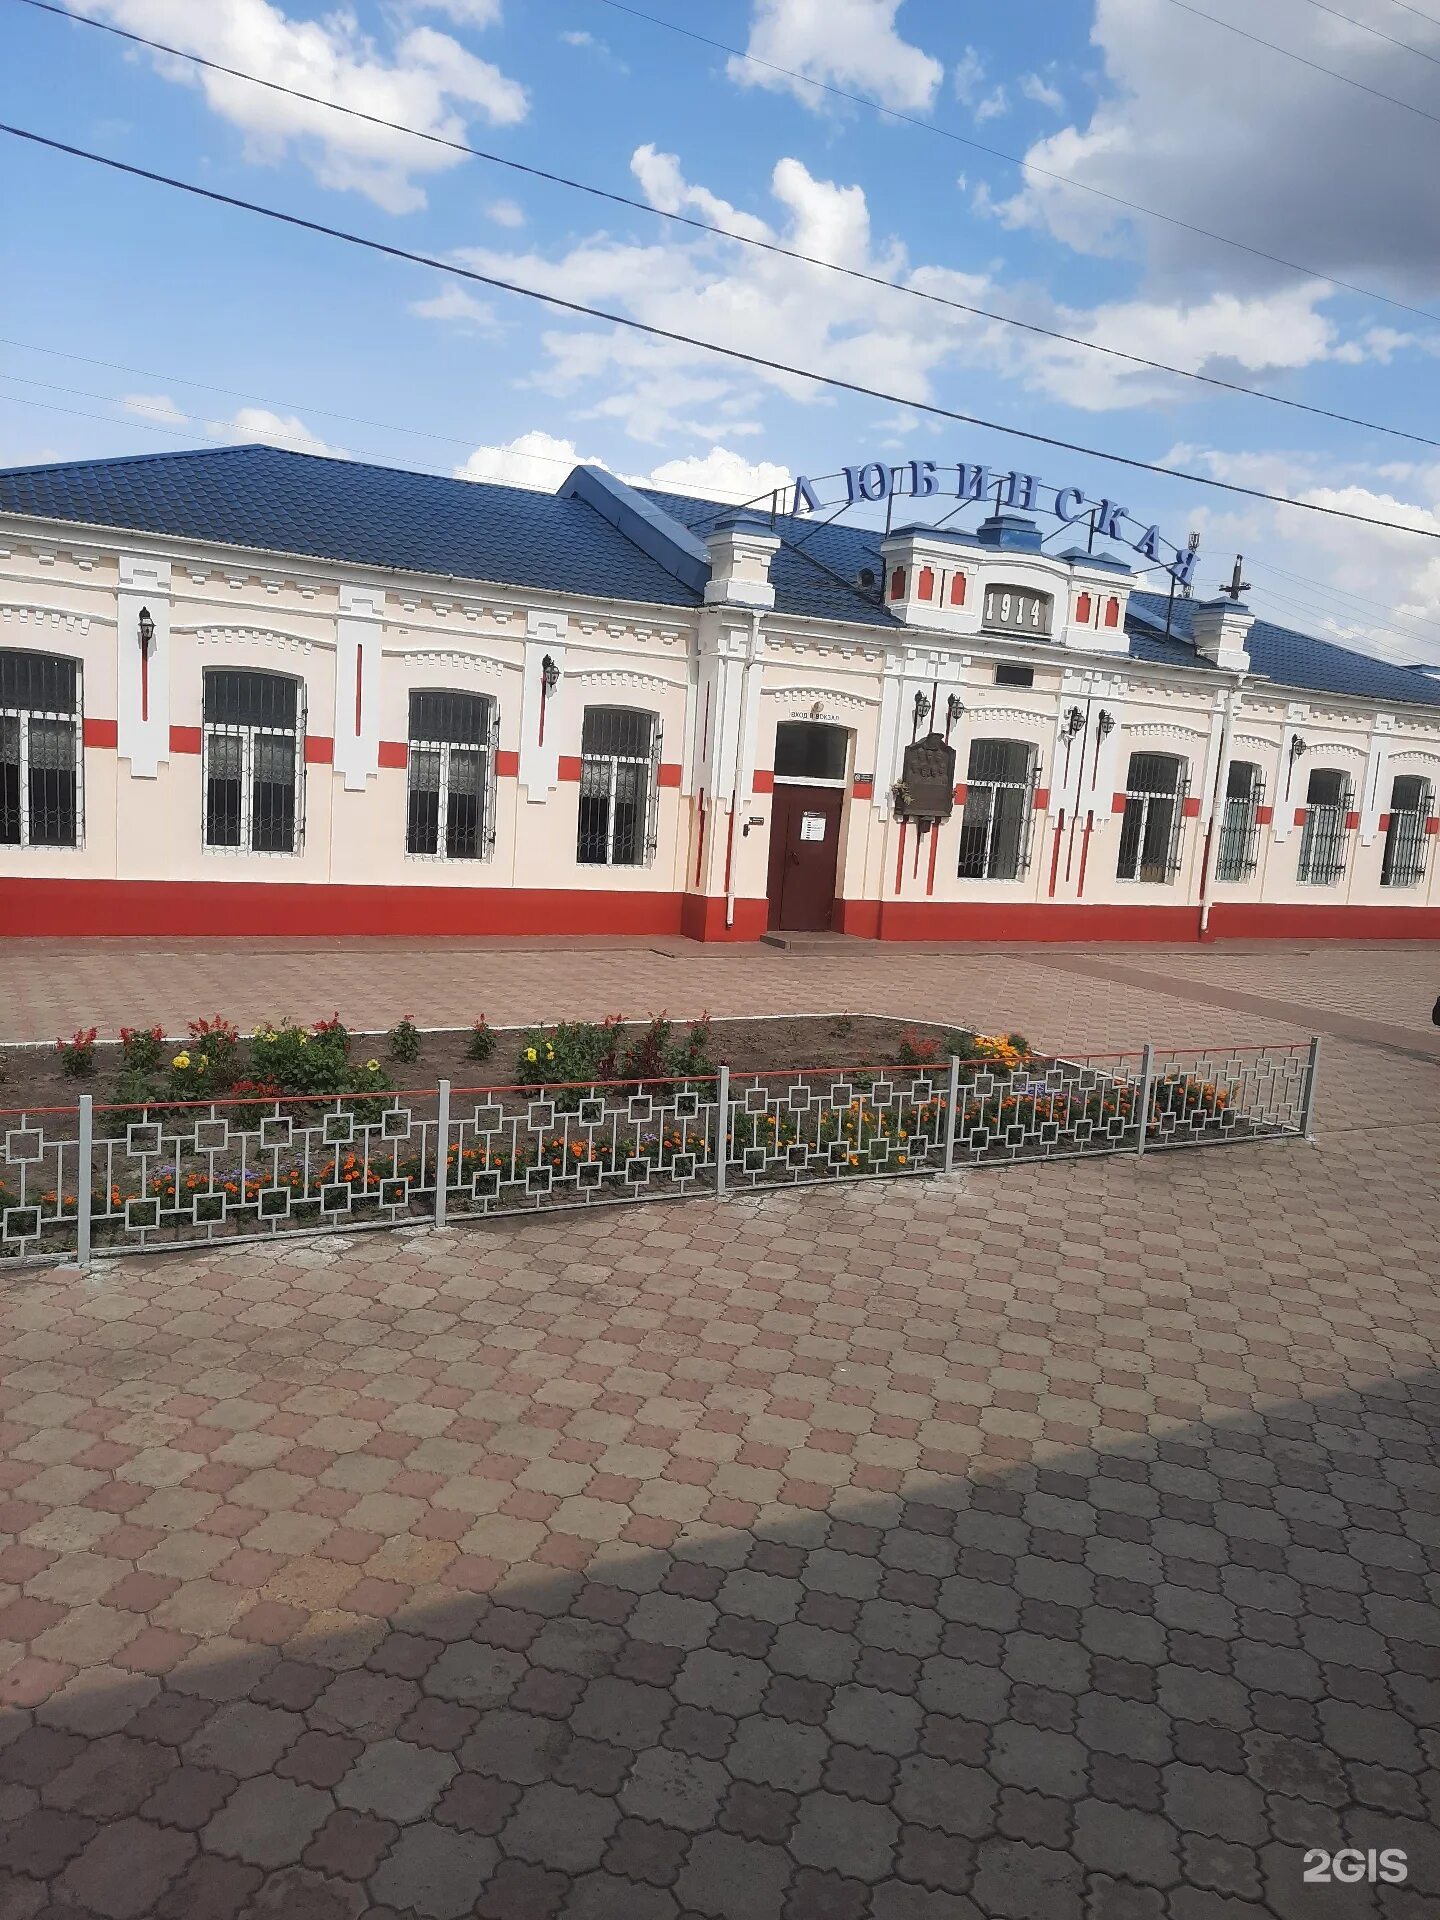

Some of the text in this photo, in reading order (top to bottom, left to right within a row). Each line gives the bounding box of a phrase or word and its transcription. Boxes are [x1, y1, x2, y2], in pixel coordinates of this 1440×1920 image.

[792, 460, 1201, 587] ЛЮБИНСКАЯ
[986, 592, 1040, 627] 1914
[791, 711, 808, 720] ВХОД
[815, 713, 840, 722] ВОКЗАЛ
